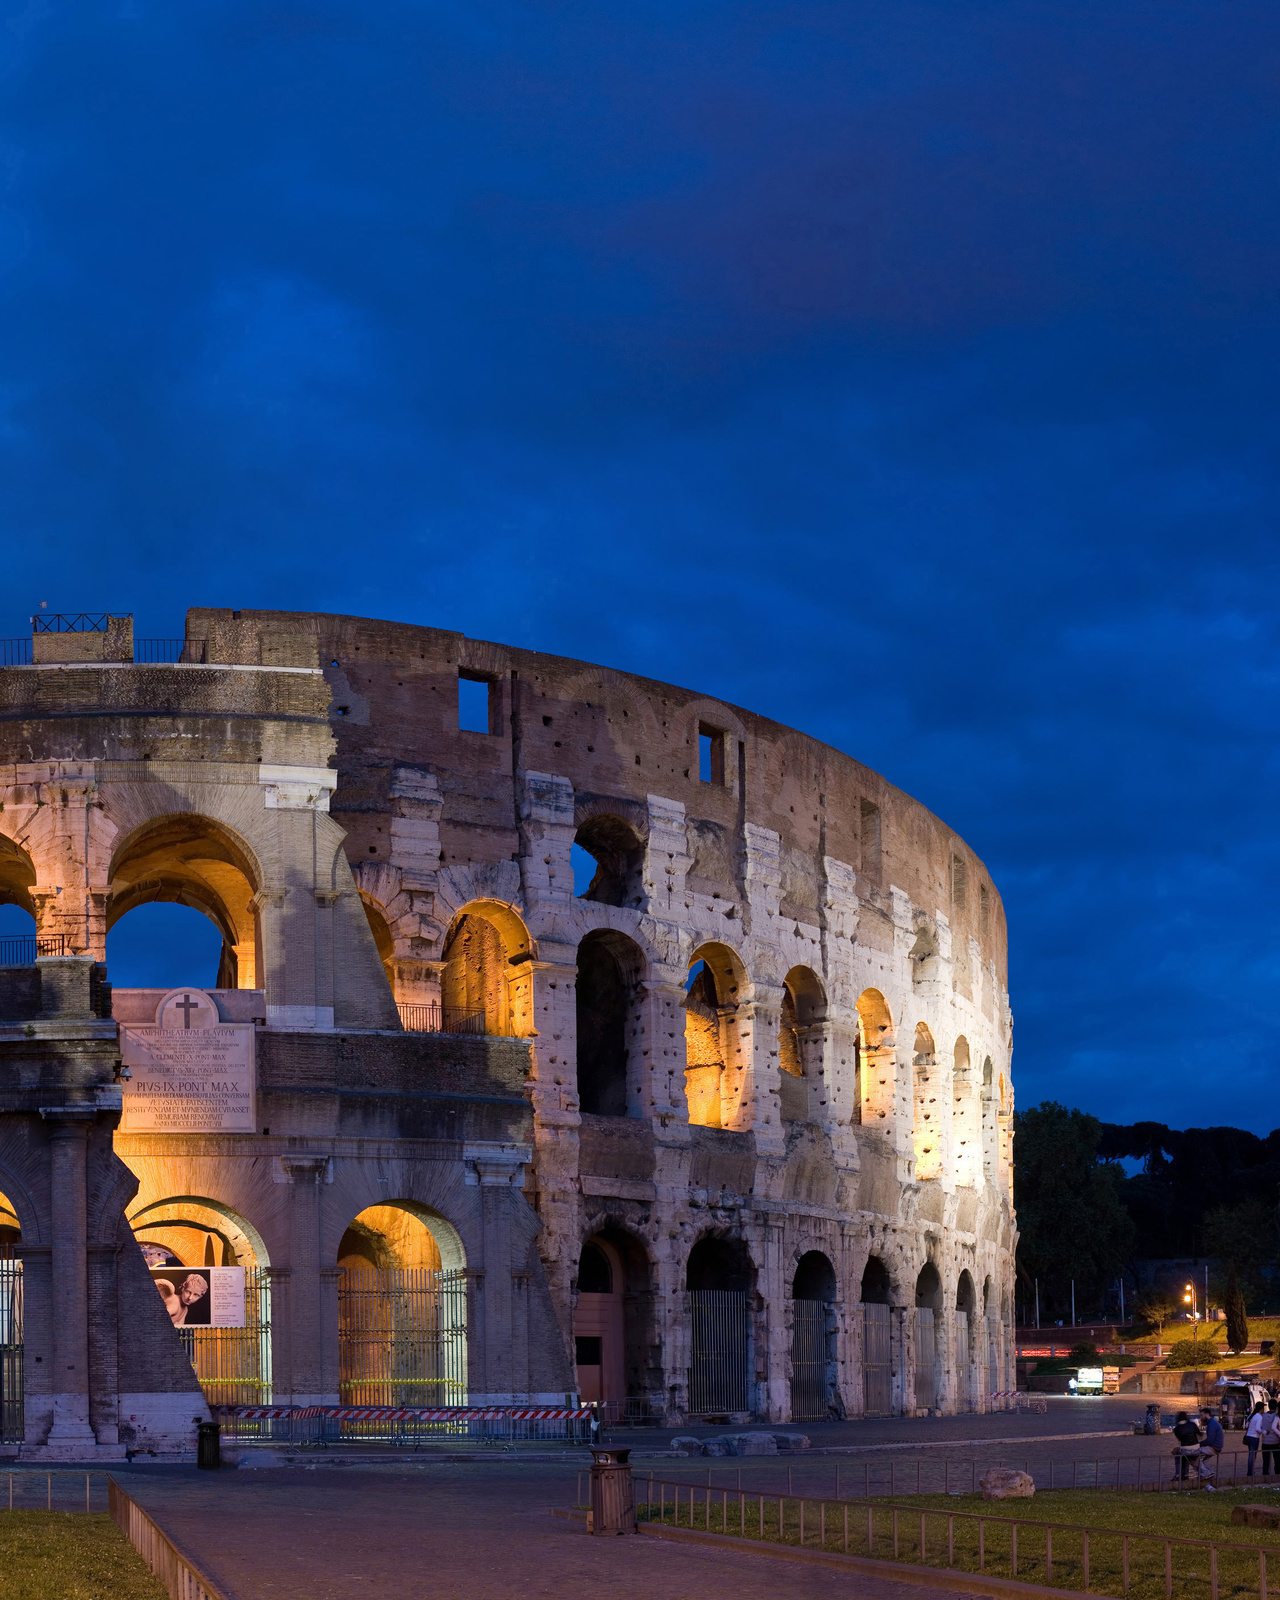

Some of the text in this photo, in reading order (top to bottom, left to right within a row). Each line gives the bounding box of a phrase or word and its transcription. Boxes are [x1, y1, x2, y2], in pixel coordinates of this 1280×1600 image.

[137, 1082, 239, 1092] PIVS IX PONT MAX
